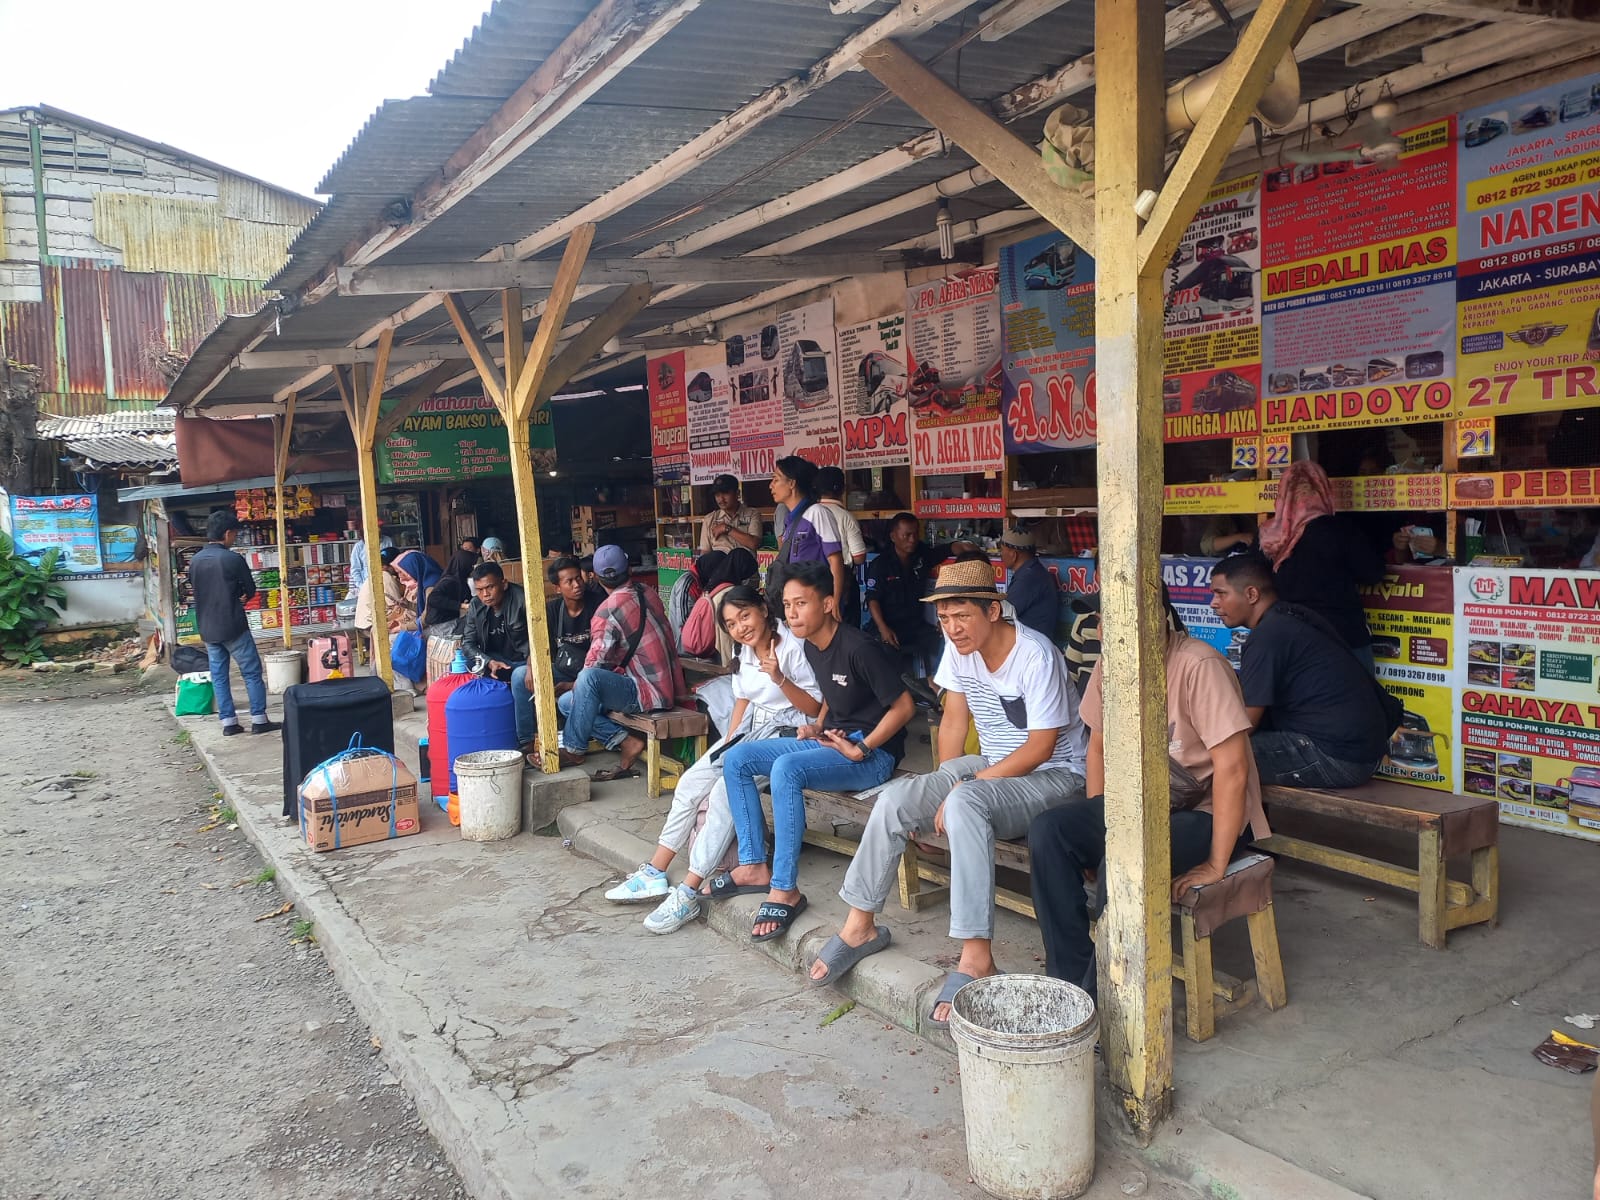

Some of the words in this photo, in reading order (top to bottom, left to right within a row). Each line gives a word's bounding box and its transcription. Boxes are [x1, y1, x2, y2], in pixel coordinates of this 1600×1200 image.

[1507, 137, 1554, 157] JAKARTA
[1488, 153, 1544, 174] MAOSPATI
[1512, 171, 1536, 184] AGEN
[1538, 168, 1553, 178] BUS
[1555, 161, 1579, 174] AKAP
[1476, 190, 1506, 206] 0812
[1510, 181, 1541, 198] 8722
[1545, 173, 1576, 190] 3028
[1480, 255, 1508, 270] 0812
[1511, 249, 1541, 264] 8018
[1544, 242, 1576, 256] 6855
[1267, 252, 1369, 297] MEDALI
[1378, 236, 1448, 274] MAS
[938, 280, 967, 305] AGRA
[968, 271, 995, 297] MAS
[1330, 289, 1347, 300] 0852
[1348, 286, 1365, 297] 1740
[1366, 283, 1384, 294] 8218
[1392, 278, 1411, 289] 0819
[1412, 273, 1431, 285] 3267
[1433, 270, 1453, 281] 8918
[1477, 272, 1532, 292] JAKARTA
[1463, 300, 1504, 313] SURABAYA
[1510, 292, 1550, 305] PANDAAN
[1528, 299, 1564, 311] GADANG
[1494, 360, 1524, 373] ENJOY
[1526, 355, 1555, 368] YOUR
[1557, 353, 1580, 364] TRIP
[1467, 373, 1518, 408] 27
[1267, 382, 1452, 426] HANDOYO
[403, 414, 442, 431] AYAM
[445, 412, 487, 430] BAKSO
[843, 412, 908, 451] MPM
[1165, 412, 1220, 438] TUNGGA
[1224, 409, 1257, 433] JAYA
[1327, 419, 1371, 428] EXECUTIVE
[1458, 418, 1491, 429] LOKET
[653, 425, 688, 450] Pangeran
[914, 431, 935, 466] PO.
[936, 427, 971, 465] AGRA
[972, 422, 1002, 461] MAS
[1234, 438, 1257, 446] LOKET
[1265, 434, 1289, 445] LOKET
[1461, 429, 1491, 455] 21
[740, 449, 775, 475] MIYOR
[1234, 446, 1257, 466] 23
[1266, 446, 1289, 465] 22
[1407, 475, 1442, 486] 8218
[1176, 485, 1227, 498] ROYAL
[1364, 488, 1396, 498] 3267
[1407, 486, 1442, 497] 8918
[918, 504, 942, 514] JAKARTA
[945, 503, 974, 514] SURABAYA
[977, 503, 1001, 513] MALANG
[1163, 565, 1189, 587] AS
[1412, 615, 1451, 626] MAGELANG
[1464, 605, 1486, 614] AGEN
[1487, 606, 1503, 615] BUS
[1504, 608, 1538, 617] PON-PIN
[1546, 611, 1567, 620] 0812
[1567, 612, 1589, 620] 8722
[1390, 624, 1432, 635] PRAMBANAN
[1468, 627, 1499, 636] MATARAM
[1469, 619, 1494, 628] JAKARTA
[1533, 623, 1564, 633] JOMBANG
[1388, 667, 1406, 678] 0819
[1407, 670, 1426, 680] 3267
[1426, 672, 1446, 683] 8918
[1462, 690, 1584, 727] CAHAYA
[1464, 715, 1486, 726] AGEN
[1487, 718, 1504, 727] BUS
[1505, 720, 1539, 733] PON-PIN
[1468, 727, 1500, 739] SEMARANG
[1502, 741, 1540, 753] PRAMBANAN
[1546, 747, 1569, 758] KLATEN
[1410, 769, 1446, 783] GROUP
